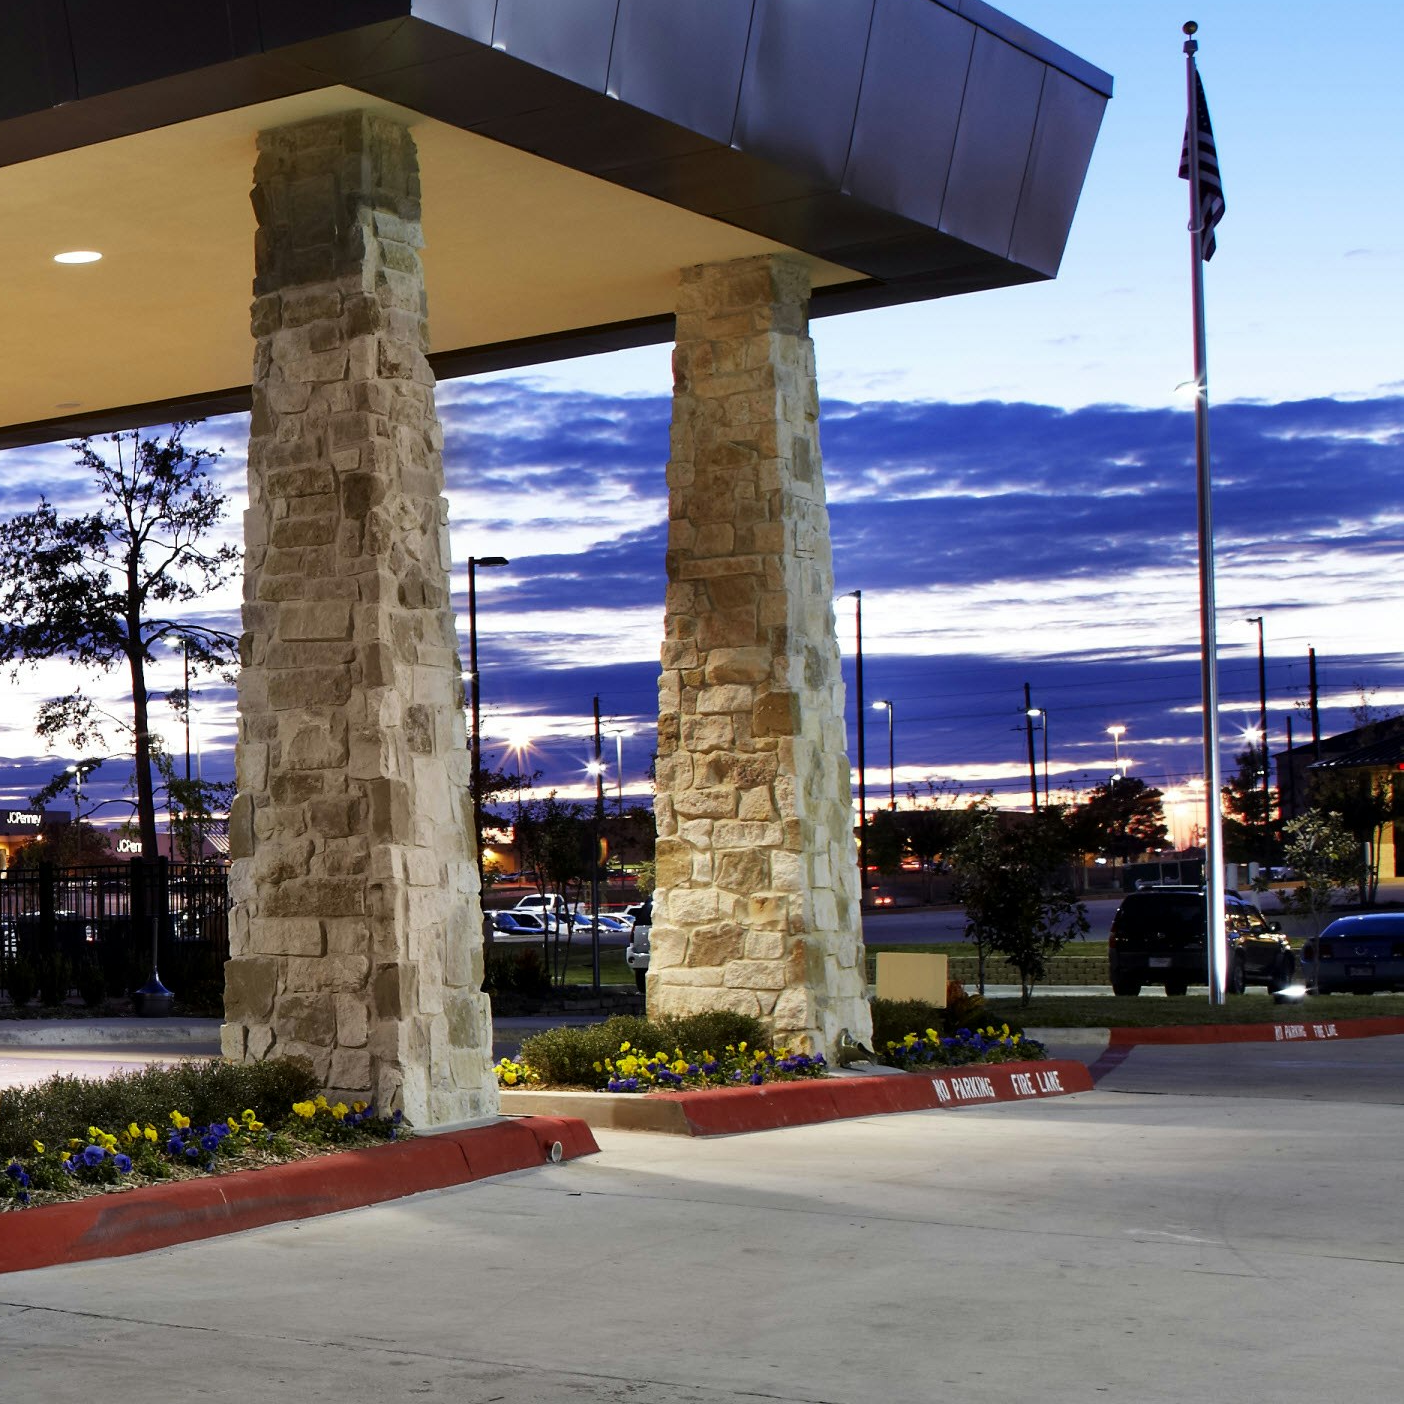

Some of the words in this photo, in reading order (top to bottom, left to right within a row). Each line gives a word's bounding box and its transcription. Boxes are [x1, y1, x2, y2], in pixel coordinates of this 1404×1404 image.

[6, 811, 42, 827] JCPenney
[932, 1078, 951, 1102] NO
[950, 1076, 995, 1099] PARKING
[1010, 1072, 1037, 1095] FIRE
[1035, 1070, 1064, 1093] LANE
